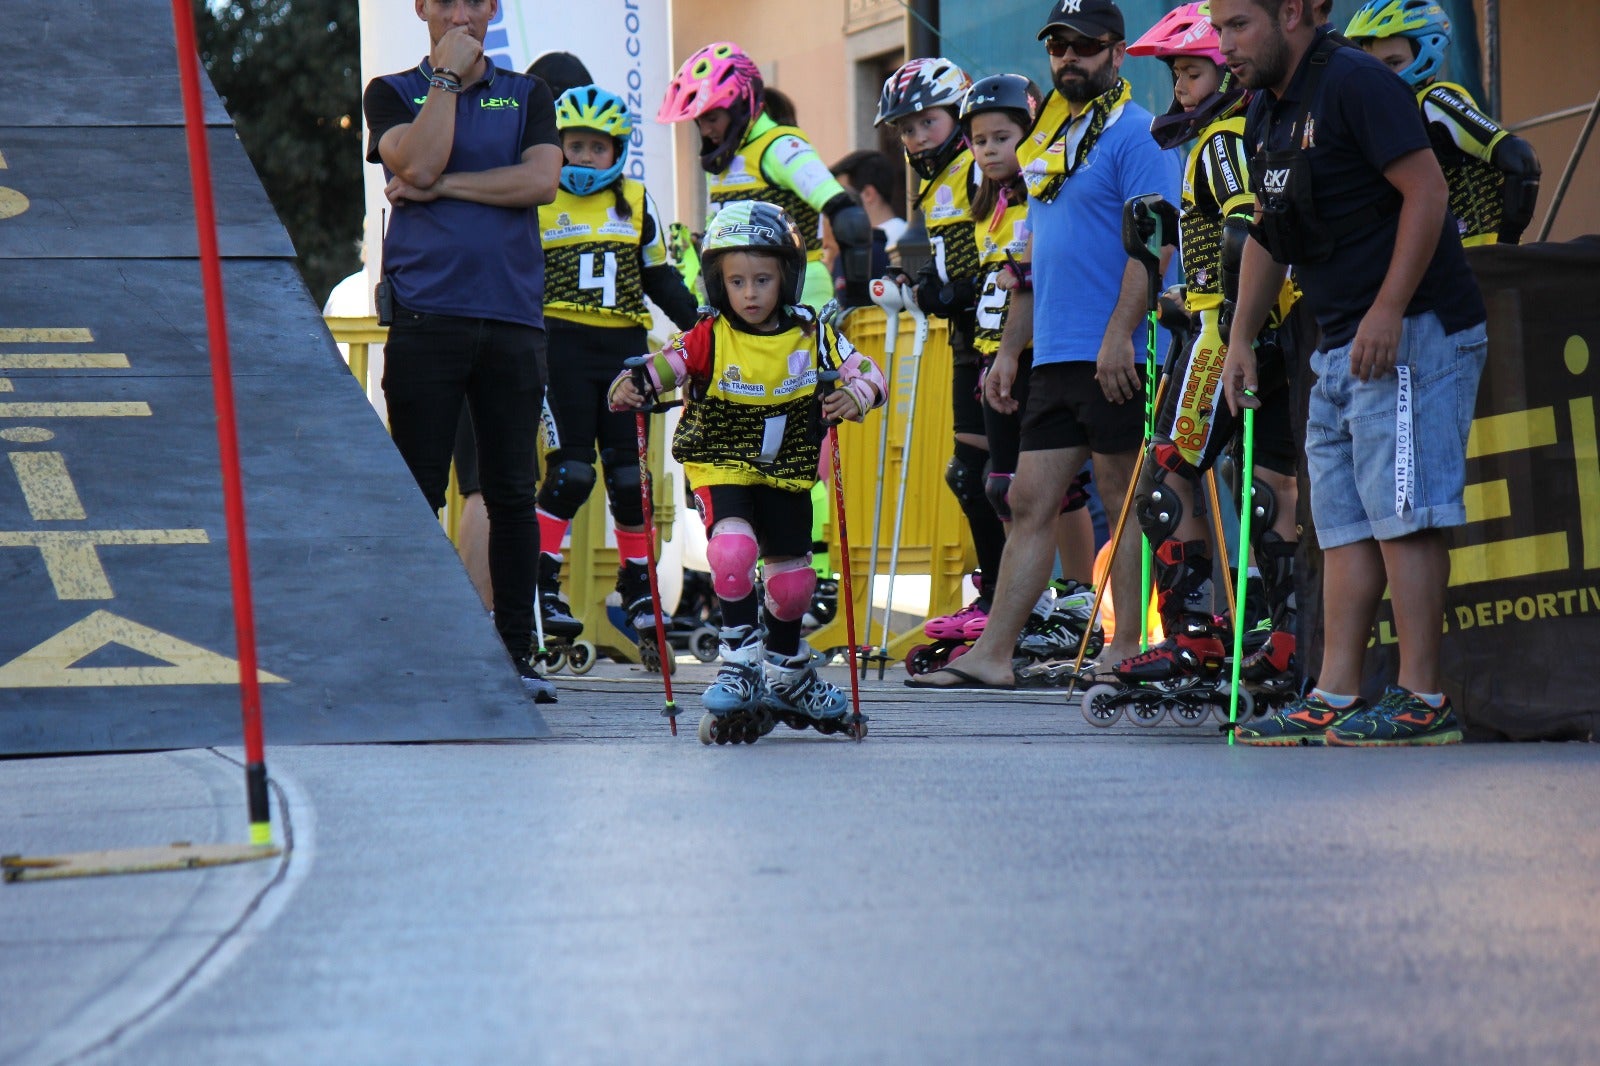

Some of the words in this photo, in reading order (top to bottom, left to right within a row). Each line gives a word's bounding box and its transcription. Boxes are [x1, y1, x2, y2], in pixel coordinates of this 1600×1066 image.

[1220, 161, 1239, 193] BIERZO
[578, 251, 617, 307] 4
[976, 271, 1008, 330] 2
[758, 414, 788, 464] 1
